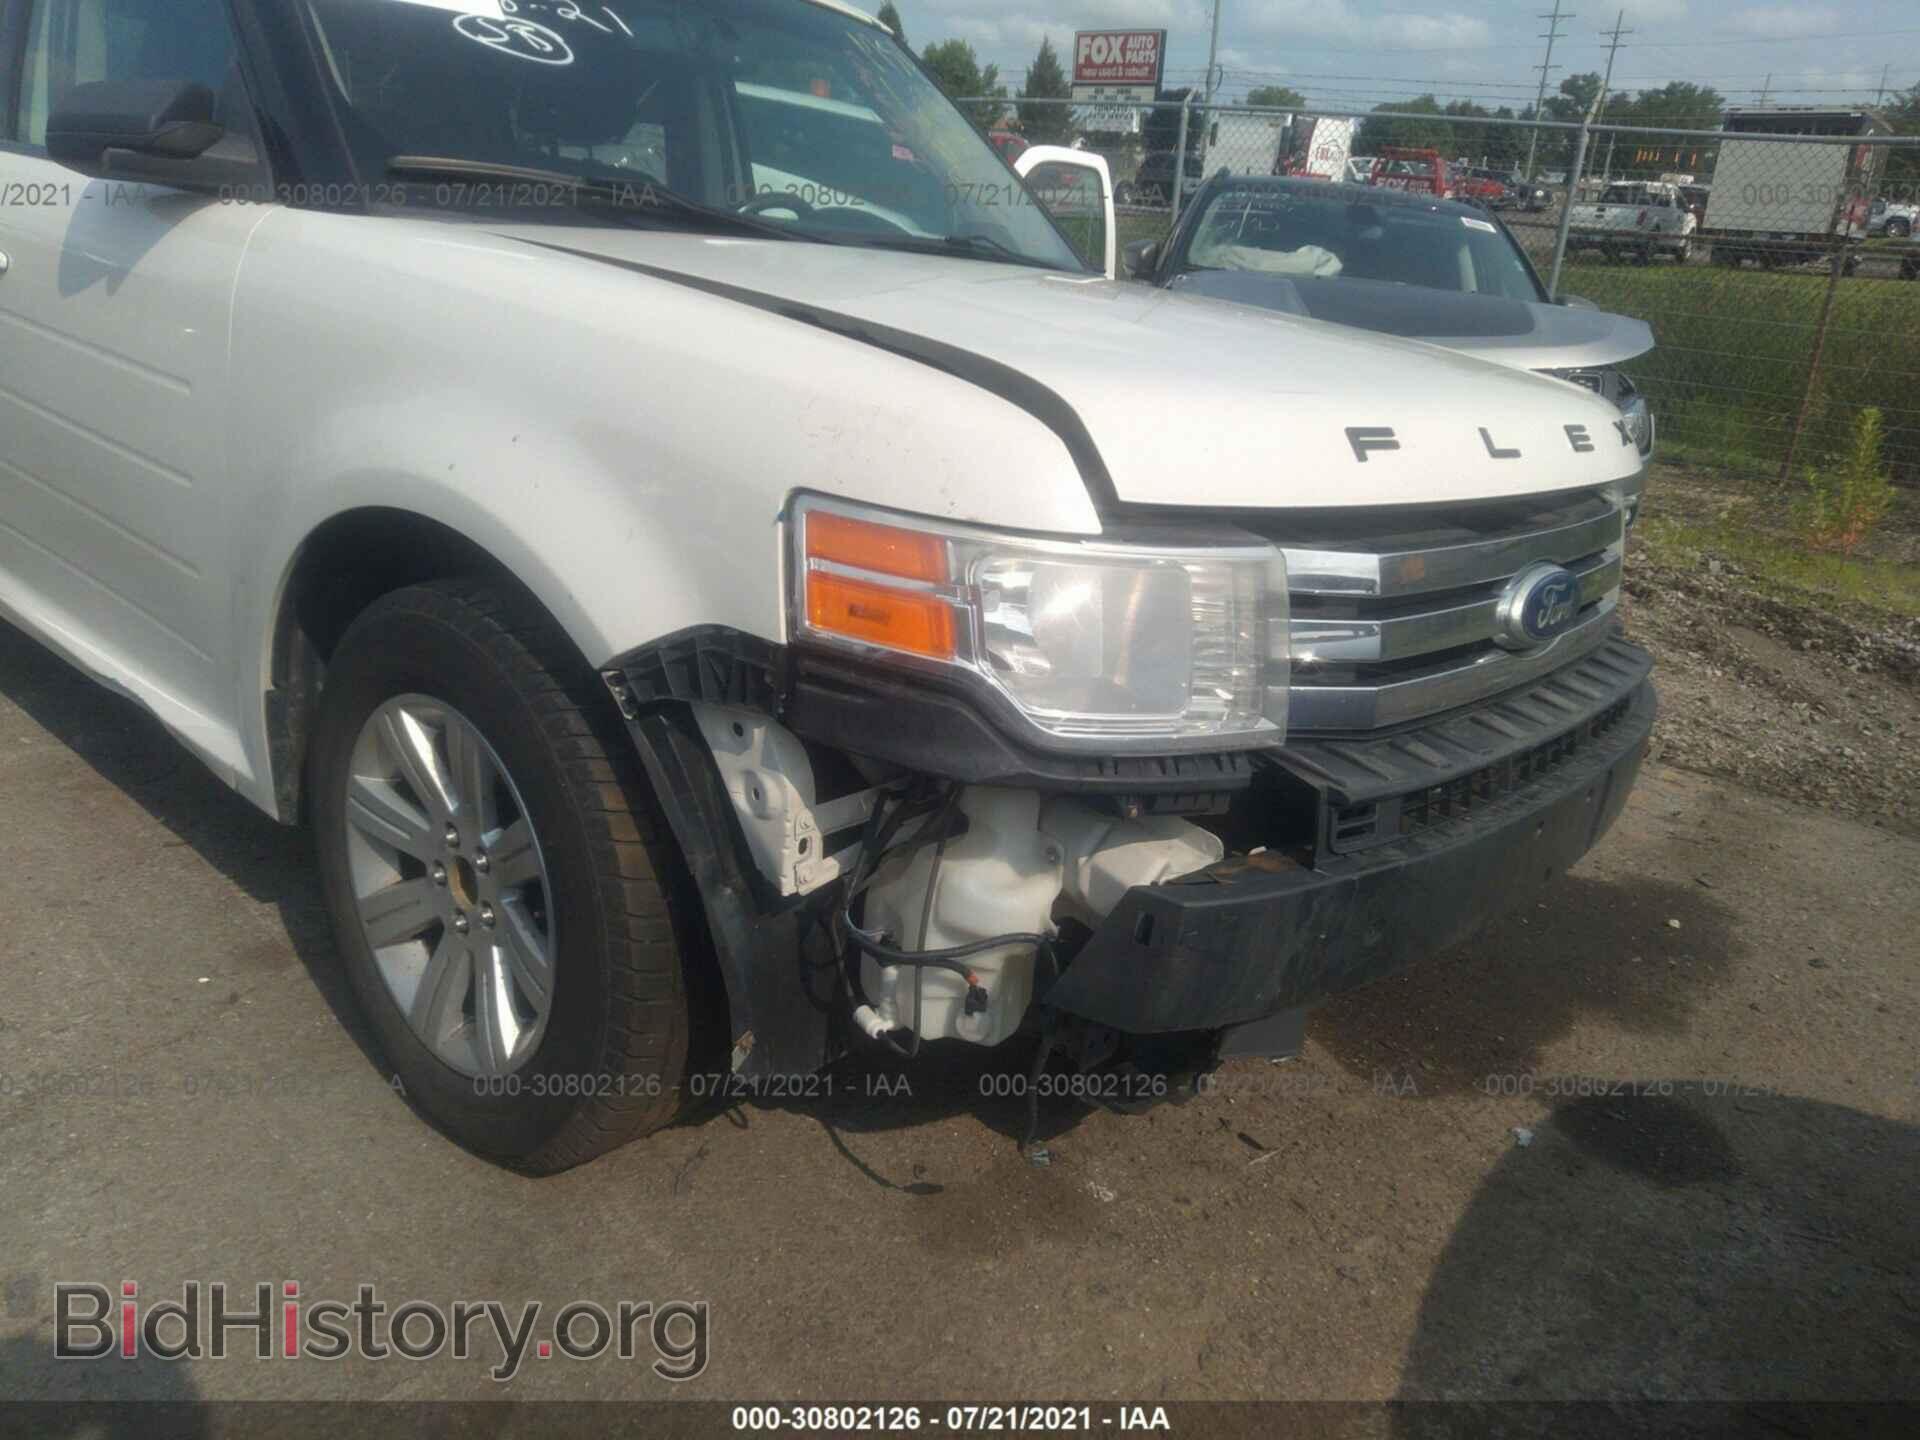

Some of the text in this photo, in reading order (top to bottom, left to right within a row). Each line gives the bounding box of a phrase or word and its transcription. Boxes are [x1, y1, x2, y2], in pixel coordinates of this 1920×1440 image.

[1079, 36, 1125, 64] FOX
[1127, 34, 1155, 49] AUTO
[1125, 49, 1157, 65] PARTS
[1344, 420, 1635, 462] FLEX
